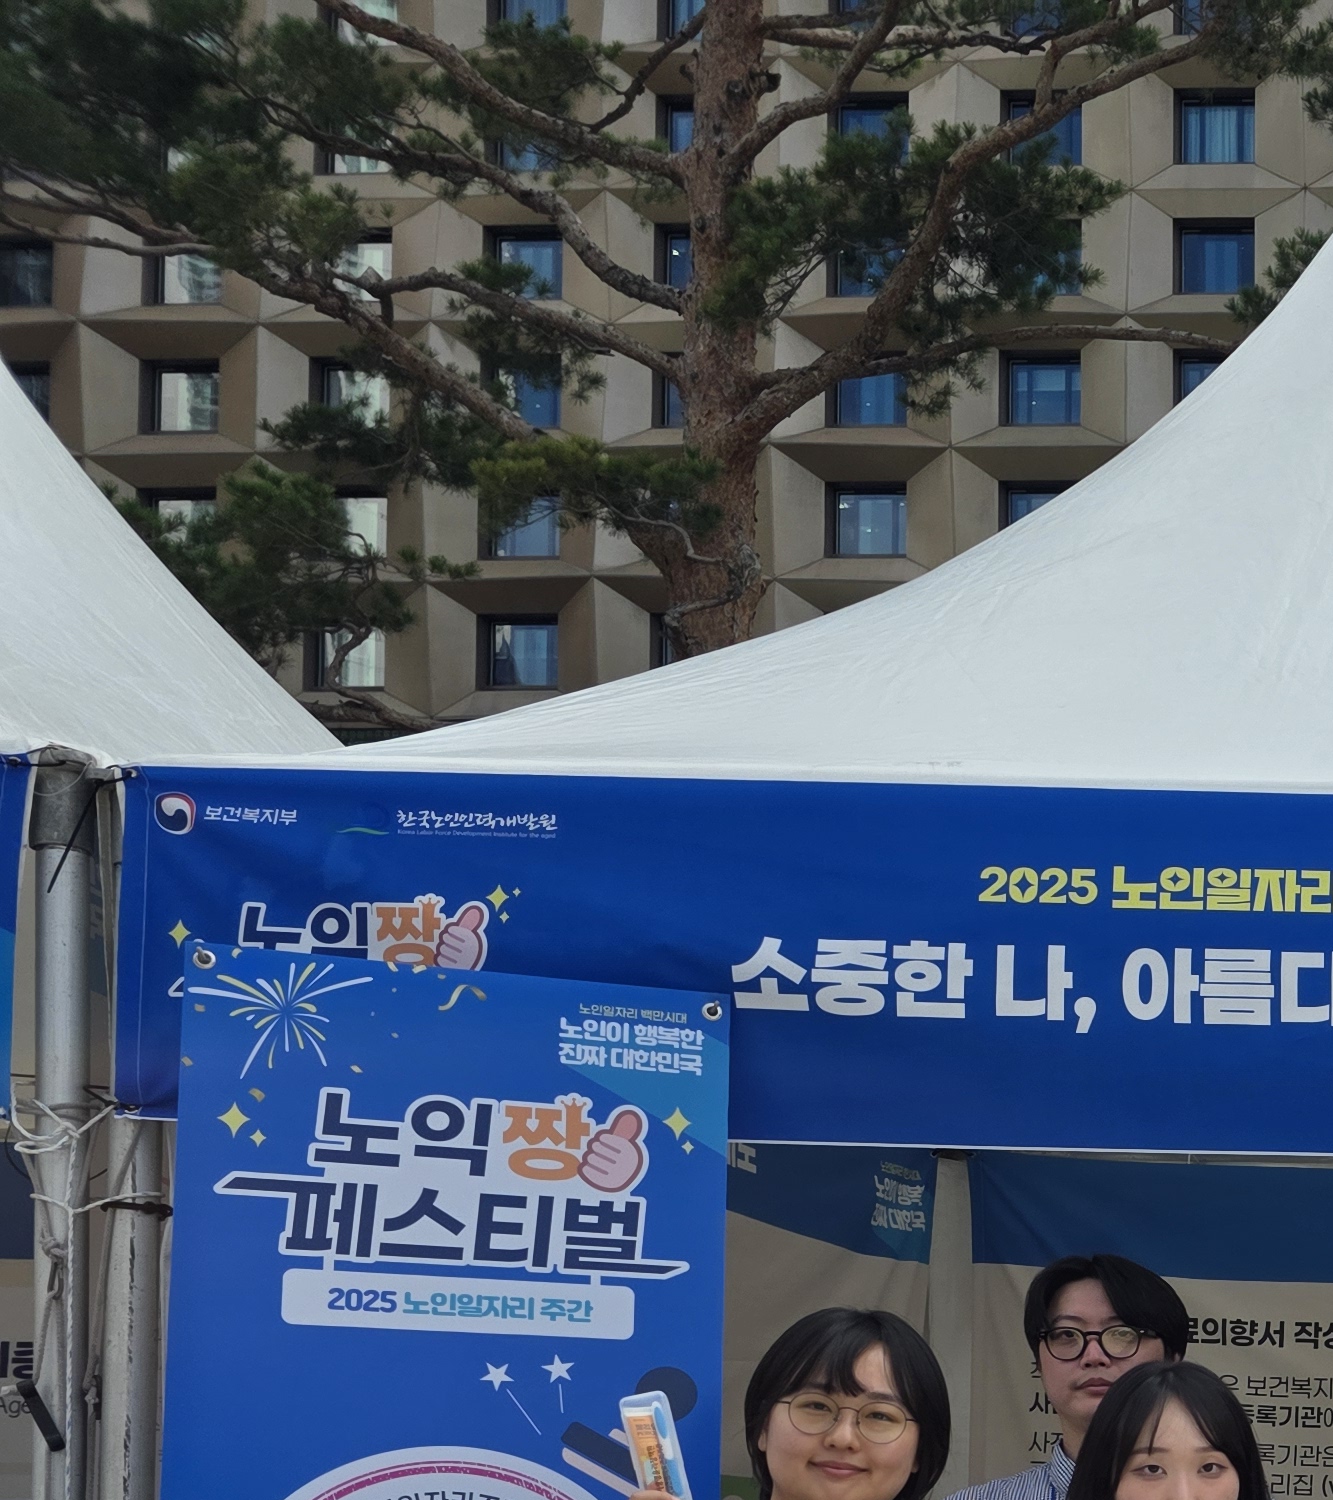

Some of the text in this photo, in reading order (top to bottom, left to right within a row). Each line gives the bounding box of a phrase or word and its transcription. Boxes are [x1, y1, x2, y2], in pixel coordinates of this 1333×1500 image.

[203, 805, 558, 831] 보건복지부 한국노인인력개발원
[978, 865, 1098, 905] 2025
[730, 936, 974, 1019] 소중한
[995, 944, 1098, 1034] 나,
[579, 1002, 688, 1024] 노인일자리 백만시대
[558, 1016, 705, 1051] 노인이 행복한
[558, 1042, 703, 1076] 진짜 대한민국
[310, 1090, 590, 1182] 노익짱
[219, 1176, 686, 1276] 페스티벌
[327, 1286, 593, 1324] 2025 노인일자리 주간
